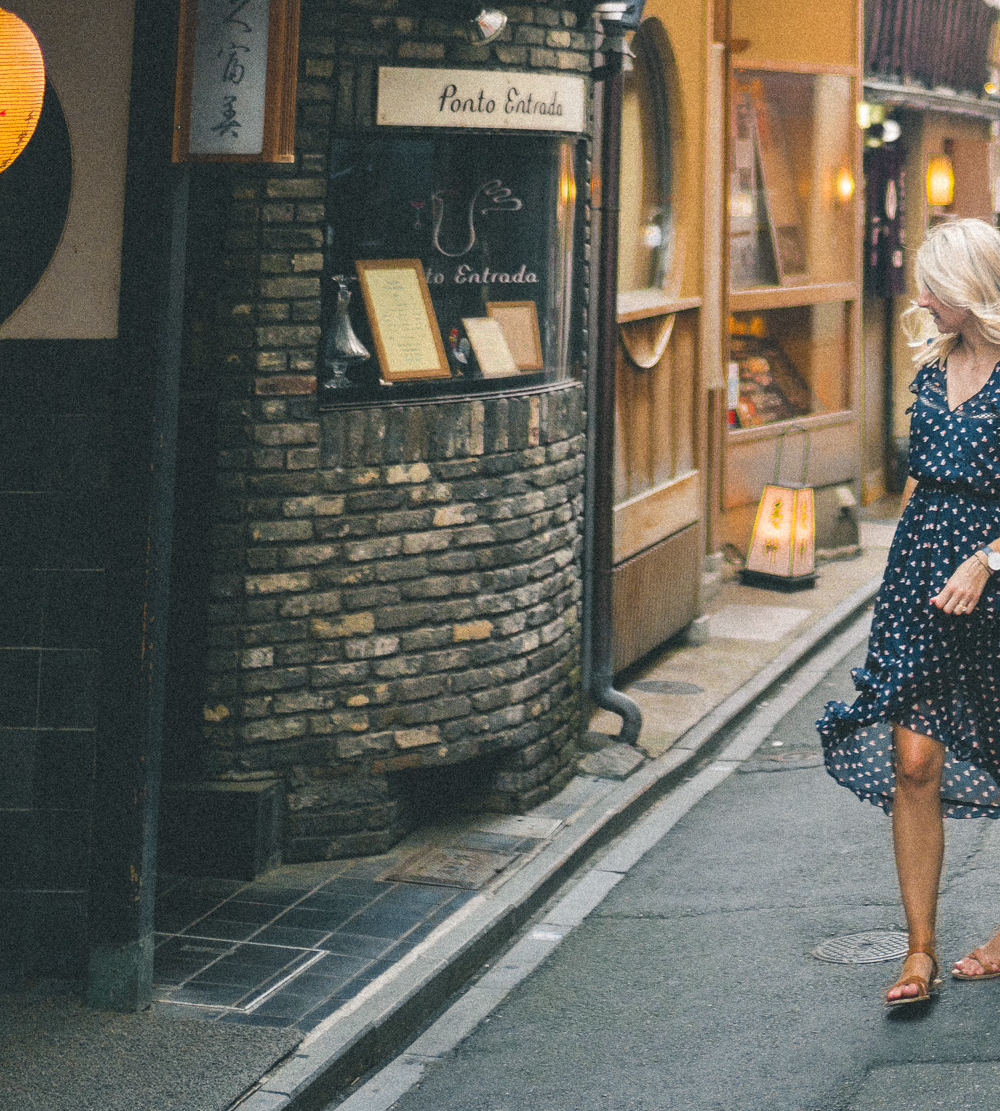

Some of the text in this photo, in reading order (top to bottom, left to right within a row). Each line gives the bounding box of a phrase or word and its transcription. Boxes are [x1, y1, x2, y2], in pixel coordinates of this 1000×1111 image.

[439, 84, 563, 117] Ponto Entrada
[454, 263, 540, 285] Entrada
